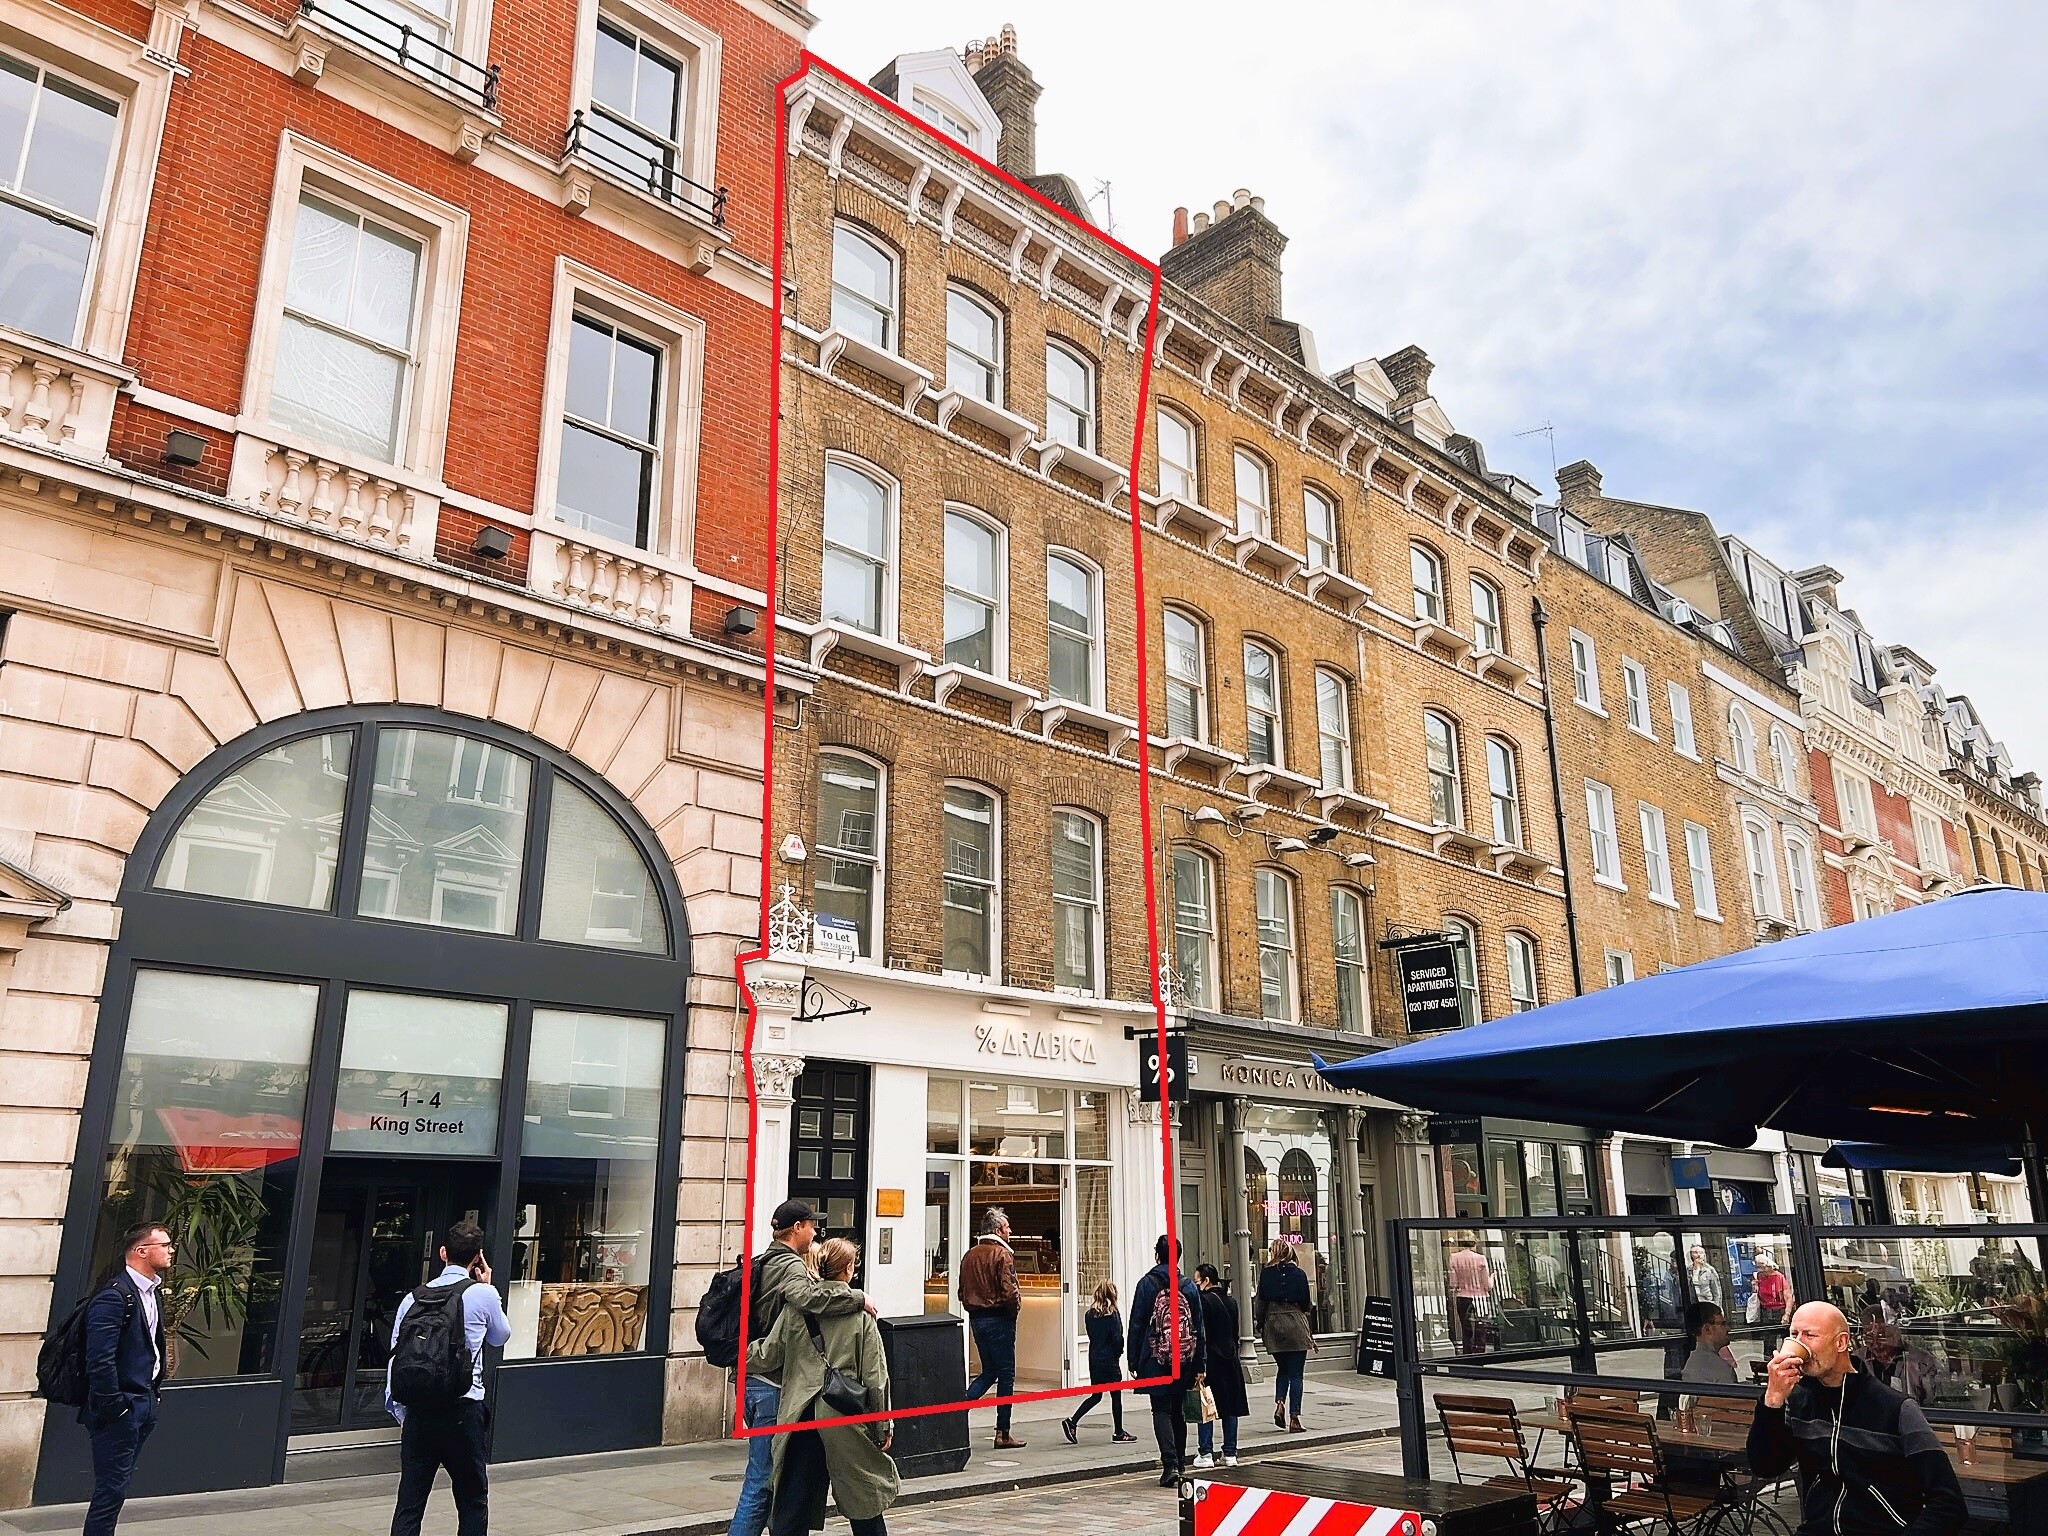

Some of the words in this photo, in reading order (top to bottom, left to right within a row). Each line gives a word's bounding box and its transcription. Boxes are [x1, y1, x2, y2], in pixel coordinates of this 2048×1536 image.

[821, 930, 833, 940] To
[835, 932, 850, 943] Let
[1411, 966, 1447, 980] SERVICED
[1407, 978, 1454, 993] APARTMENTS
[1409, 1002, 1422, 1012] 020
[1422, 1000, 1439, 1011] 7907
[1440, 998, 1458, 1008] 4501
[1002, 1028, 1097, 1064] ARABICA
[1221, 1063, 1297, 1088] MONICA
[399, 1090, 409, 1108] 1
[429, 1091, 442, 1109] 4
[370, 1115, 409, 1135] King
[414, 1117, 464, 1134] Street
[1264, 1199, 1313, 1217] PIERCING
[820, 1227, 826, 1238] 5
[1278, 1233, 1304, 1245] STUDIO
